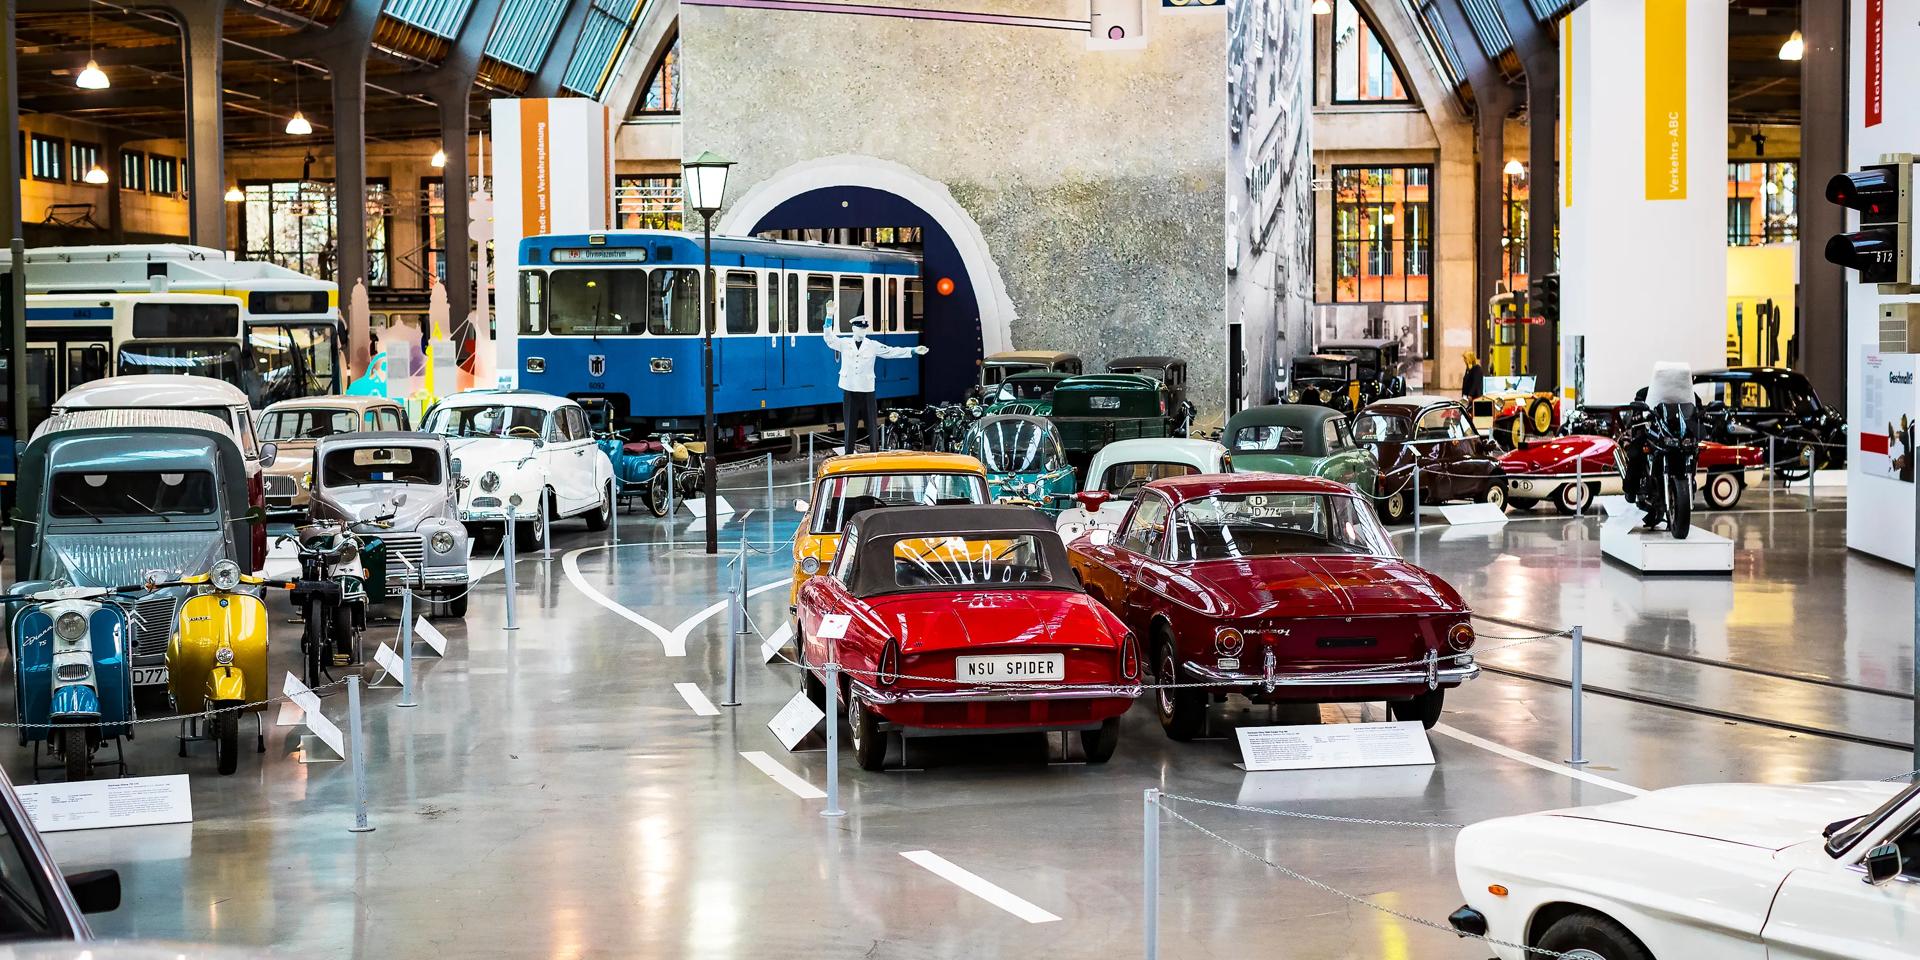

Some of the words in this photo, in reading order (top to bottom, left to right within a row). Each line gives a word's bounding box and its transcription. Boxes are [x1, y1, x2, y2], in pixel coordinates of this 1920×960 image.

[537, 122, 546, 193] Verkehrsplanung
[1668, 111, 1680, 193] Verkehrs-ABC
[538, 194, 546, 210] und
[1876, 252, 1893, 263] 512
[1255, 496, 1262, 506] D
[1254, 507, 1261, 517] D
[968, 662, 995, 676] NSU
[1006, 661, 1054, 675] SPIDER
